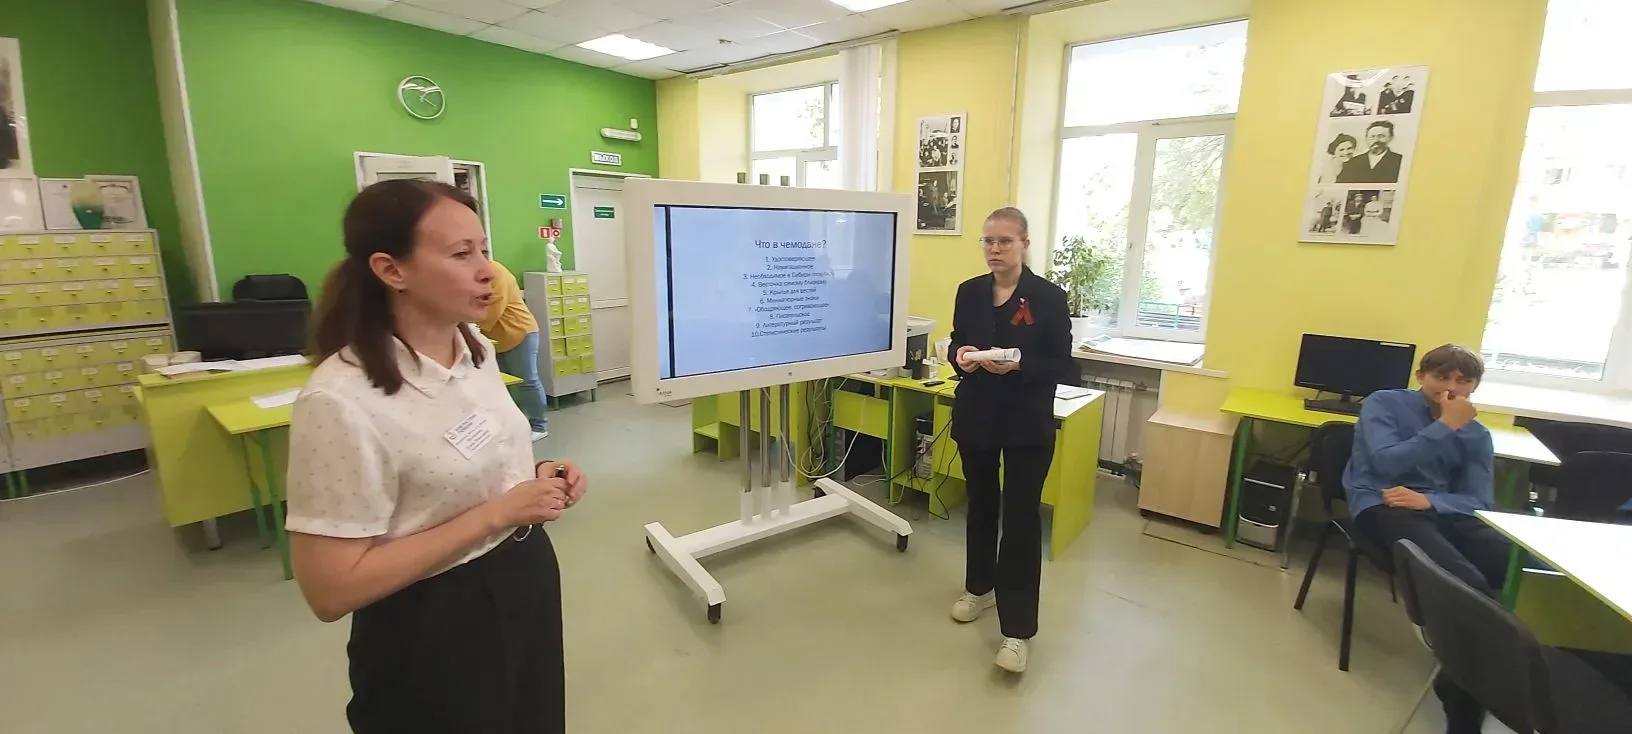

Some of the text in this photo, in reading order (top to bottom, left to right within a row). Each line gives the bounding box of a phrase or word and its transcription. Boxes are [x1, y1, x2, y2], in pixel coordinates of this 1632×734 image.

[595, 154, 618, 163] ЫХОД
[755, 240, 770, 249] Что
[780, 240, 827, 249] чемодане?
